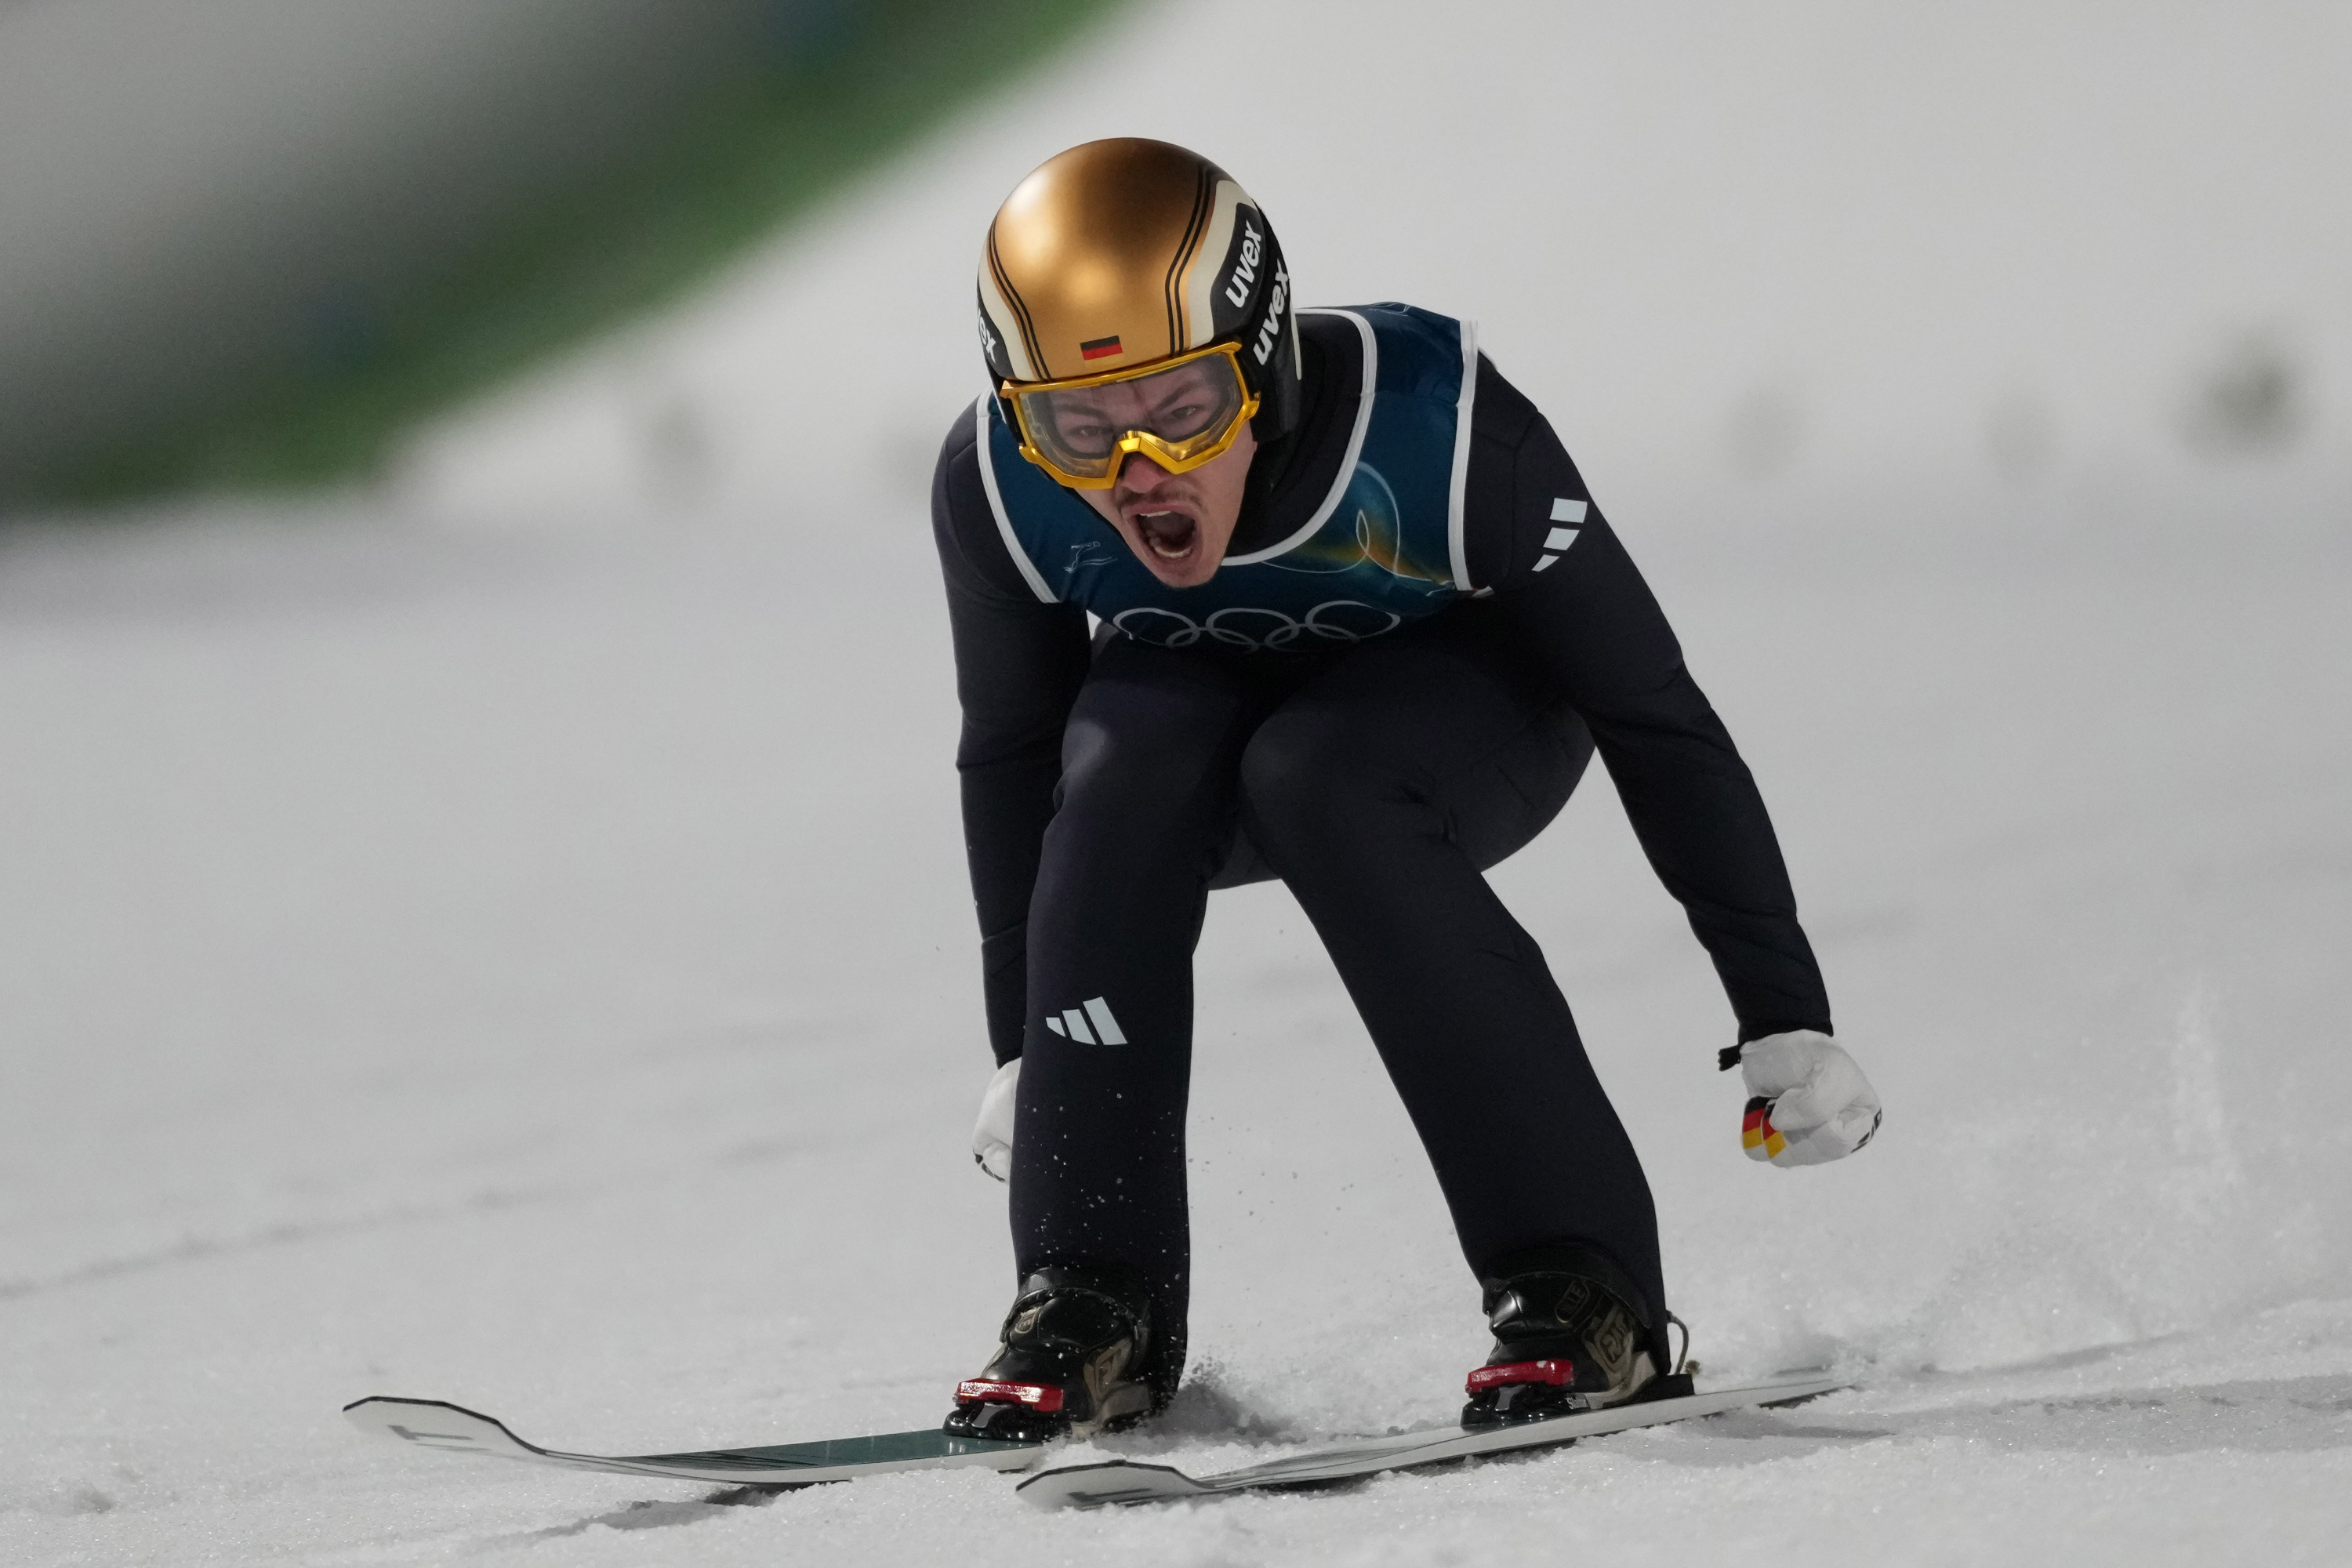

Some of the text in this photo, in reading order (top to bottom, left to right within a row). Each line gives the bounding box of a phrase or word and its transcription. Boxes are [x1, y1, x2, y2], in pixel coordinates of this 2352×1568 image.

[1225, 220, 1261, 308] uvex
[977, 307, 996, 364] ex
[1253, 258, 1290, 365] uvex
